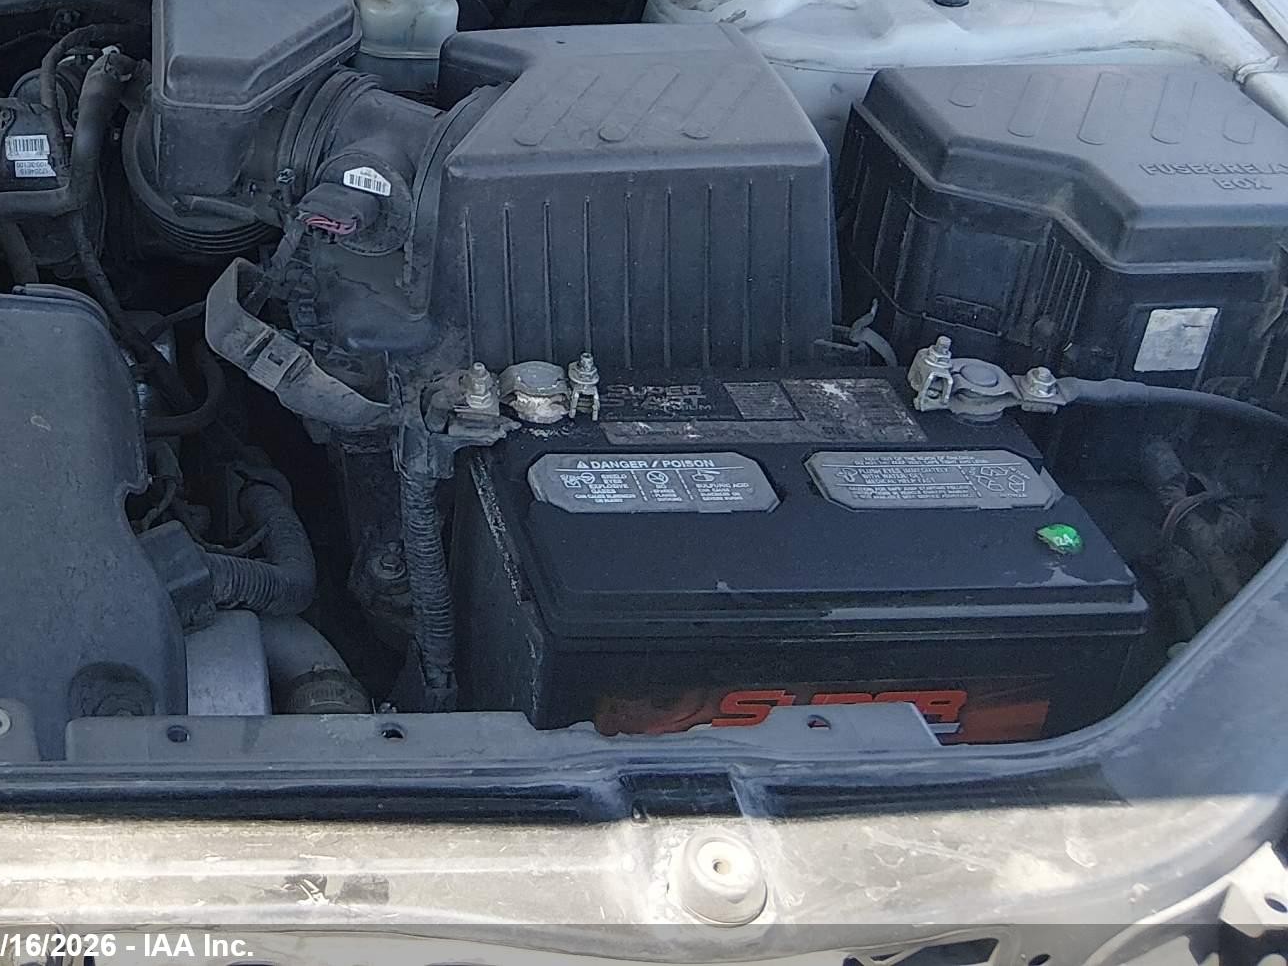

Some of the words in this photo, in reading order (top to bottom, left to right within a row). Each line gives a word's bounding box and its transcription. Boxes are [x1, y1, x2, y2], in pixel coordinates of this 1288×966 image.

[1213, 177, 1272, 190] BOX
[607, 384, 702, 395] SUPER
[589, 460, 649, 469] DANGER
[662, 459, 715, 468] POISON
